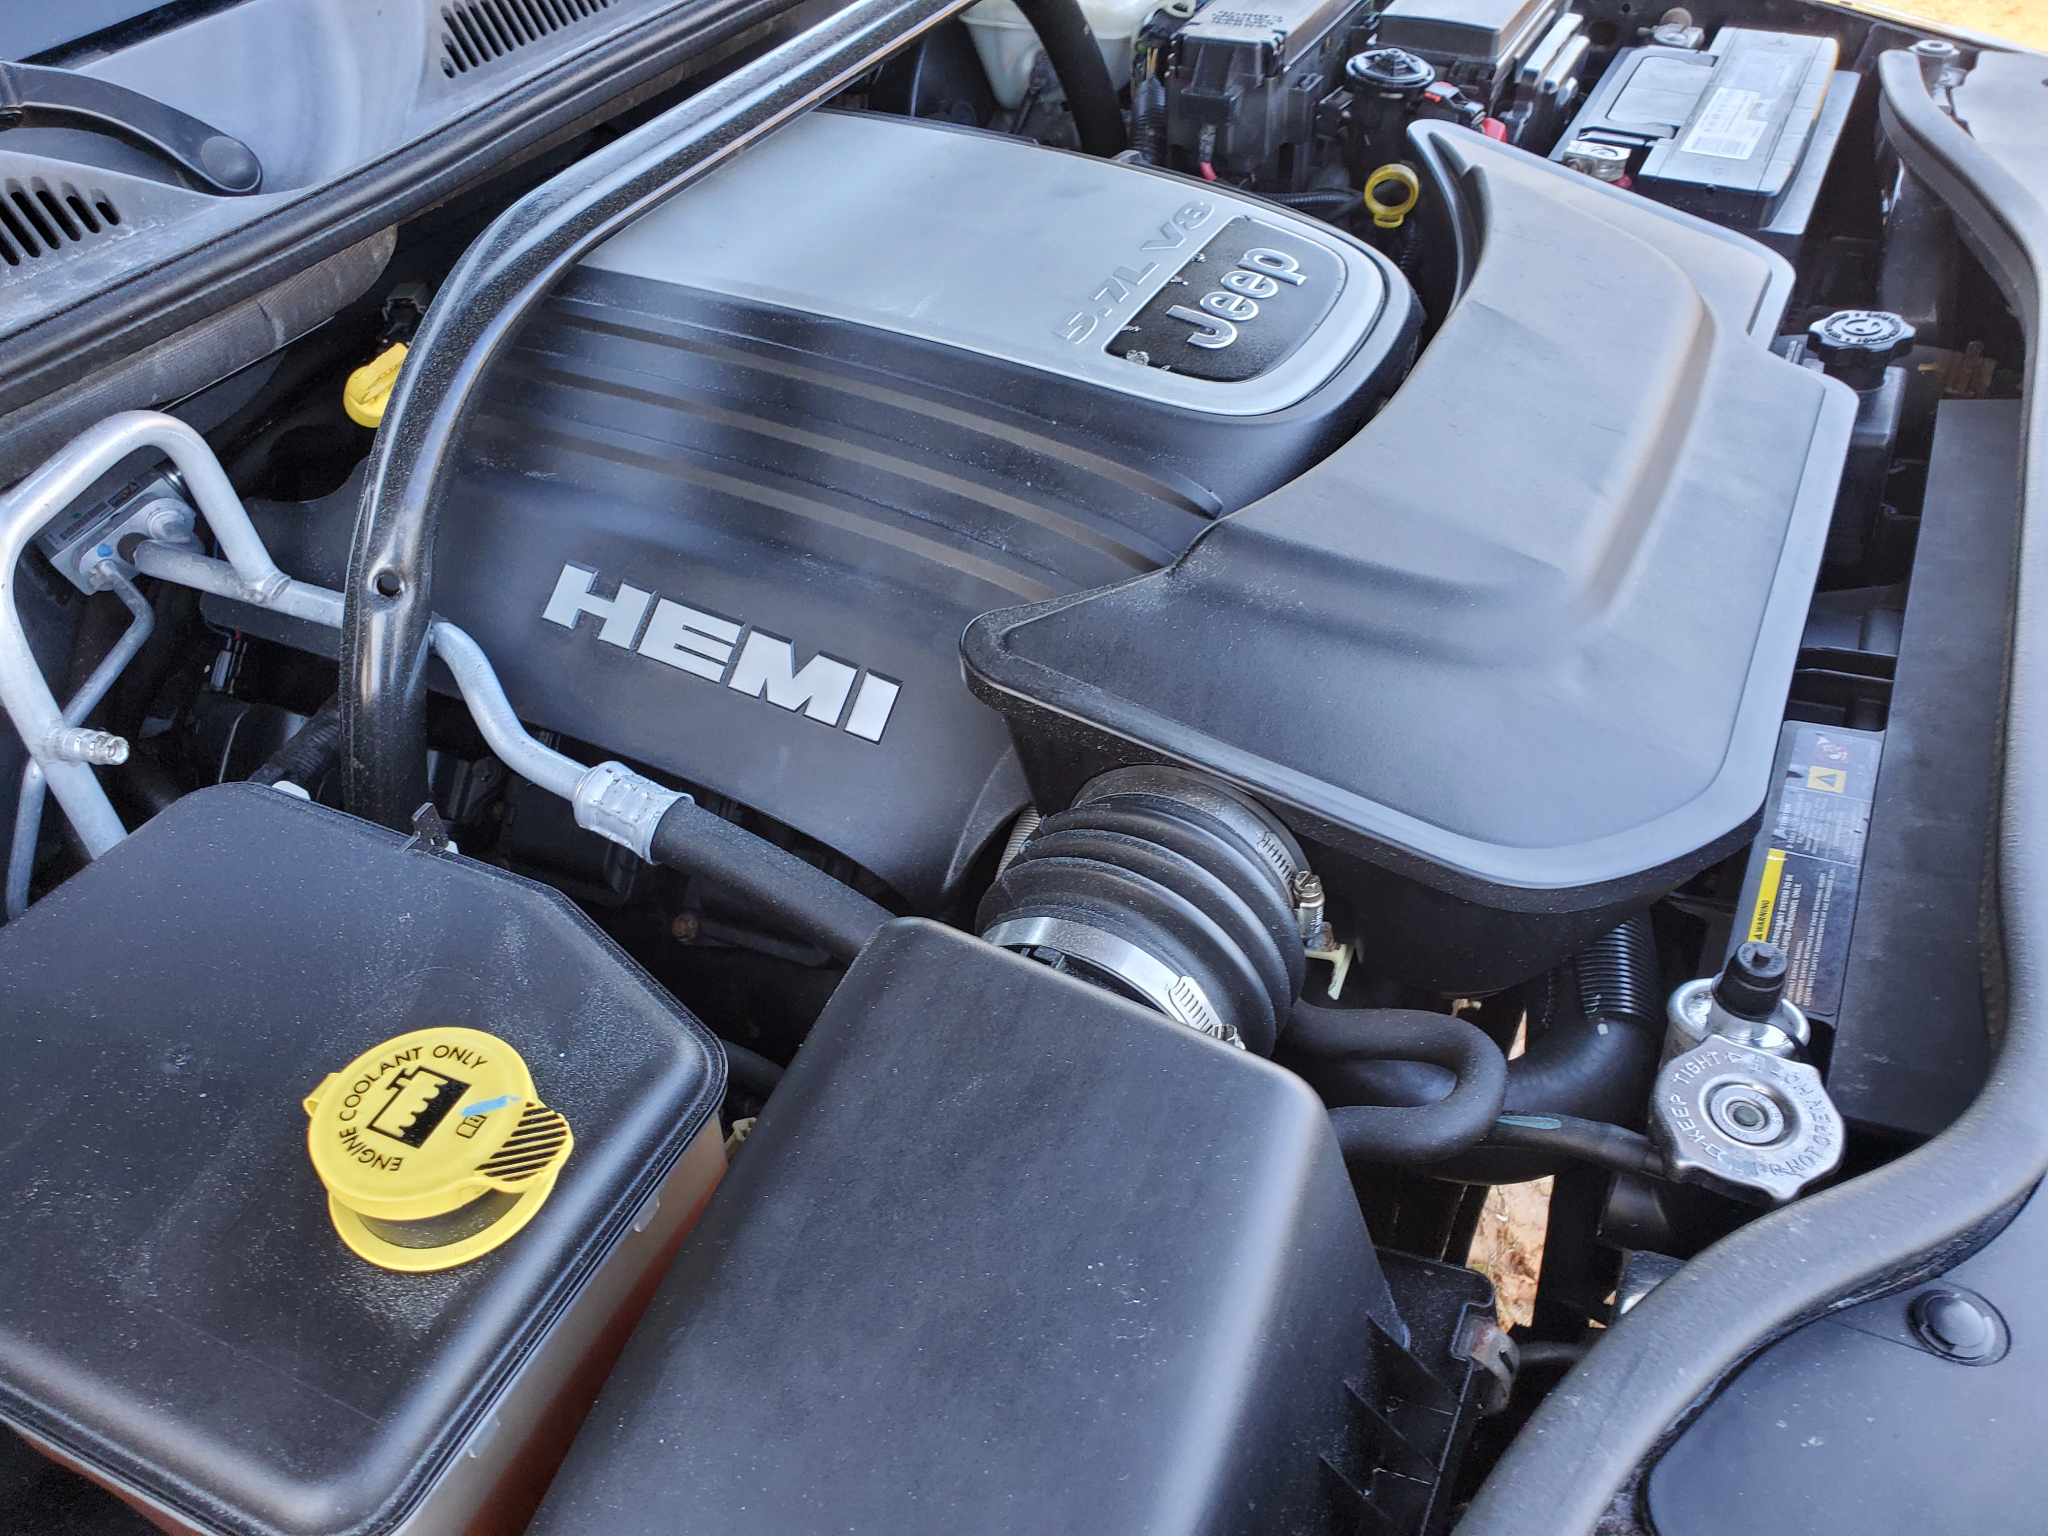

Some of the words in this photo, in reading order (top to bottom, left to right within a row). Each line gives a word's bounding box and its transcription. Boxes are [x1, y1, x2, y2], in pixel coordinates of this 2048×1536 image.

[1054, 263, 1160, 344] 5.7L
[1140, 200, 1215, 250] V8
[1165, 247, 1308, 349] Jeep
[542, 560, 904, 745] HEMI
[1783, 881, 1792, 889] TO
[1785, 874, 1793, 882] BE
[1756, 900, 1770, 932] WARNING
[1778, 889, 1790, 911] SYSTEM
[1784, 898, 1799, 931] PERSONNEL
[1770, 911, 1785, 948] EFRIGERANT
[1802, 986, 1814, 1007] SYSTEM
[432, 1045, 488, 1069] ONLY
[1673, 1051, 1721, 1084] TIGHT
[339, 1046, 423, 1121] COOLANT
[1669, 1094, 1705, 1143] KEEP
[339, 1126, 403, 1171] ENGINE
[1785, 1146, 1823, 1176] NOT
[1804, 1099, 1832, 1148] OPEN
